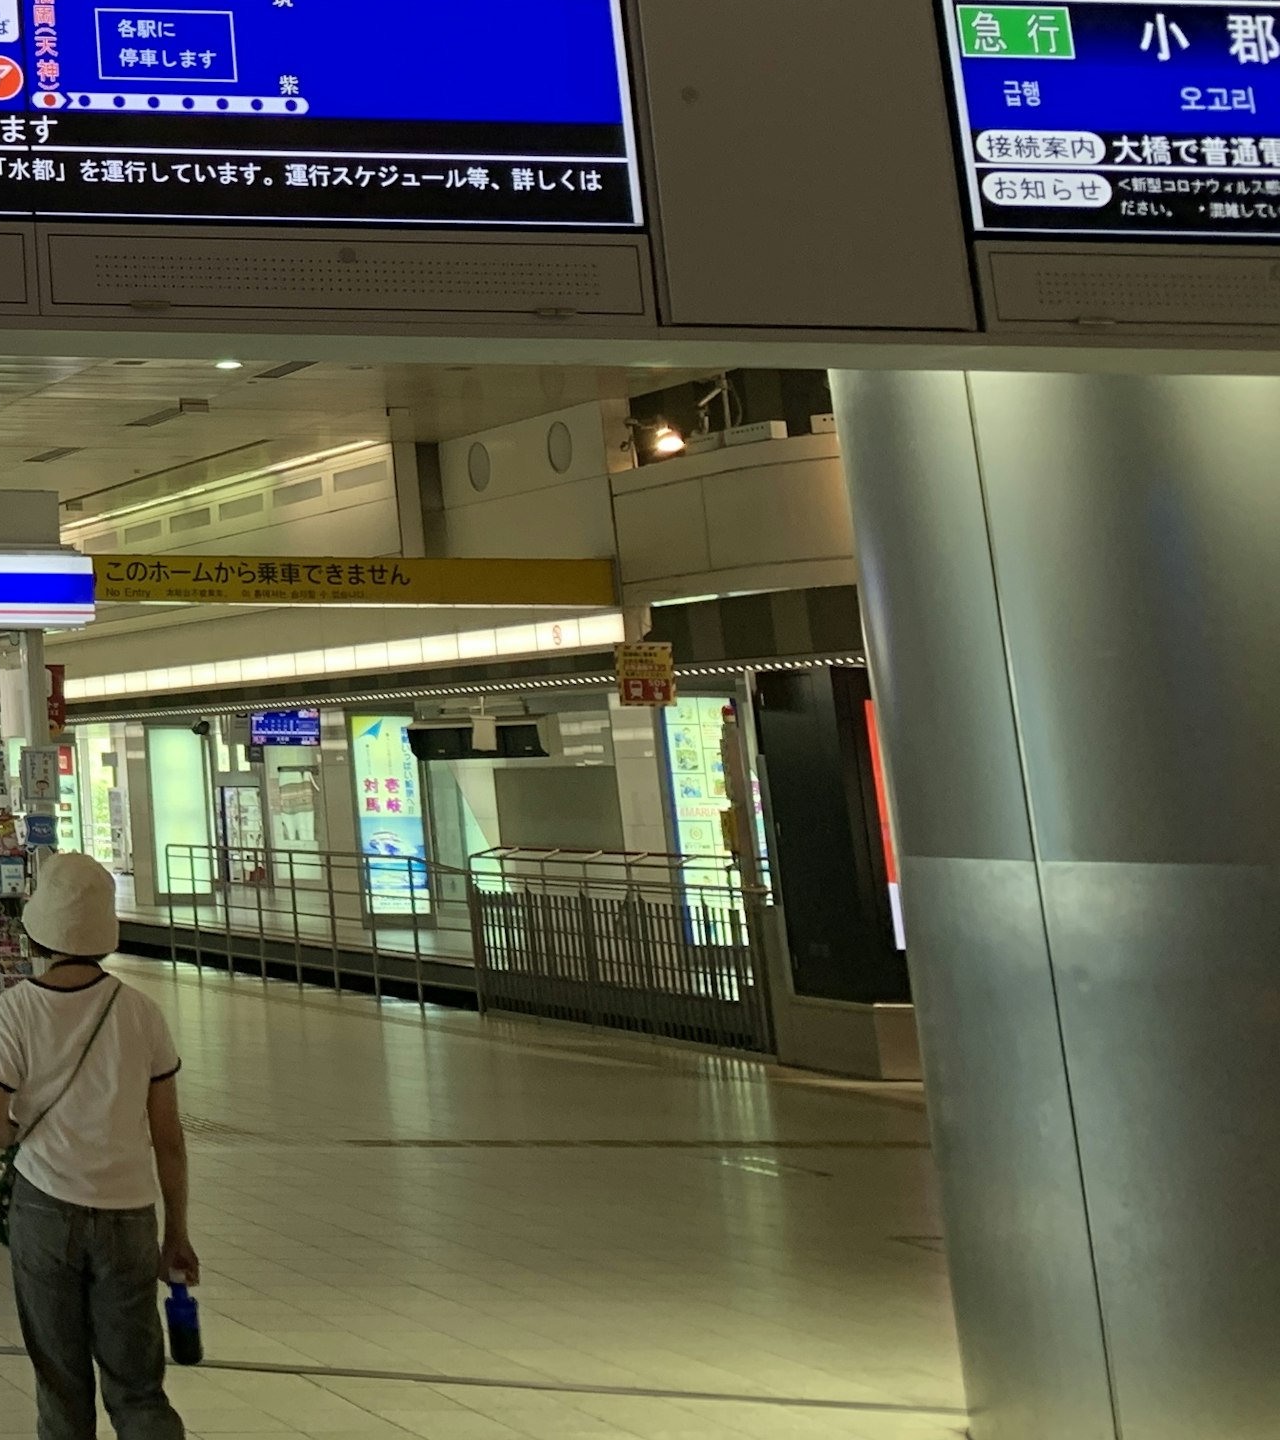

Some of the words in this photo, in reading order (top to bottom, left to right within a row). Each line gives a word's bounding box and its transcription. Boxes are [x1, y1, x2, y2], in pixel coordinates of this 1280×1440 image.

[970, 10, 1061, 54] 急行
[1139, 12, 1280, 65] 小郡
[993, 176, 1103, 202] お知らせ
[105, 560, 412, 587] このホームから乗車できません
[105, 587, 121, 598] No
[124, 587, 152, 600] Entry
